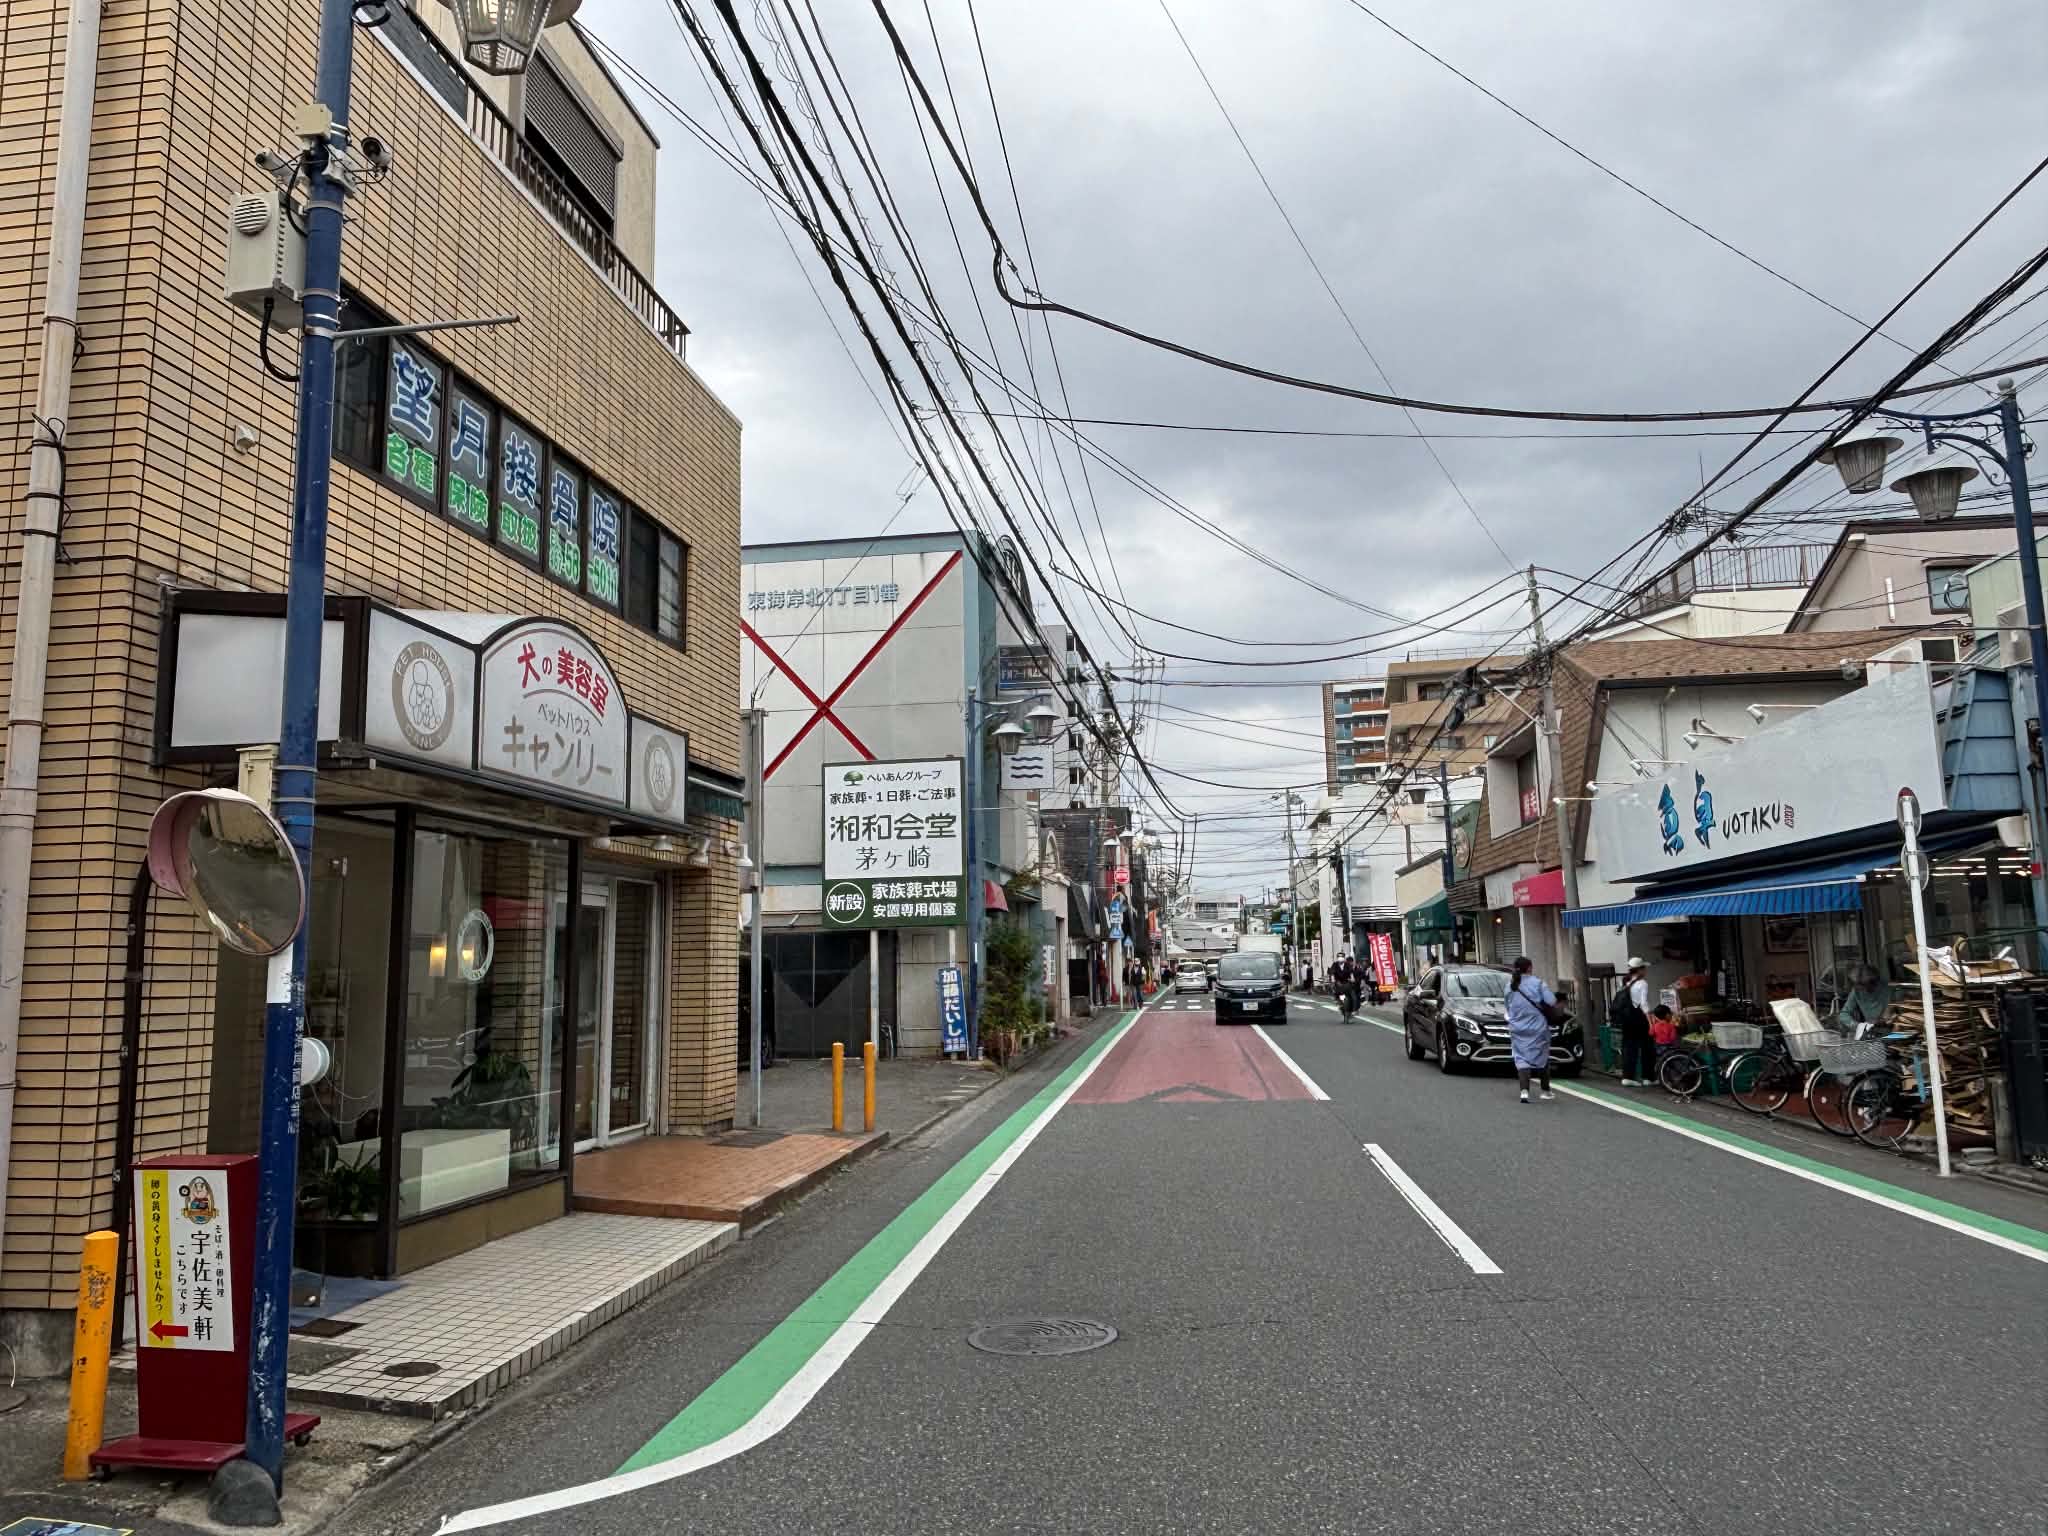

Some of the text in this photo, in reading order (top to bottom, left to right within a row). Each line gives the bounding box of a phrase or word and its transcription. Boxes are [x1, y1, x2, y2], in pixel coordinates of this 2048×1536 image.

[390, 350, 618, 561] 望月接骨院
[517, 641, 609, 718] 犬の美容室
[502, 713, 613, 786] キャンリー
[867, 769, 943, 783] へいあんグループ
[830, 811, 957, 843] 湘和会堂
[1722, 800, 1781, 840] UOTAKU
[828, 893, 863, 911] 新設
[871, 880, 958, 899] 家族葬式場
[872, 902, 957, 918] 安置専用個室
[176, 1244, 189, 1315] こちらです
[191, 1230, 213, 1341] 宇佐美軒
